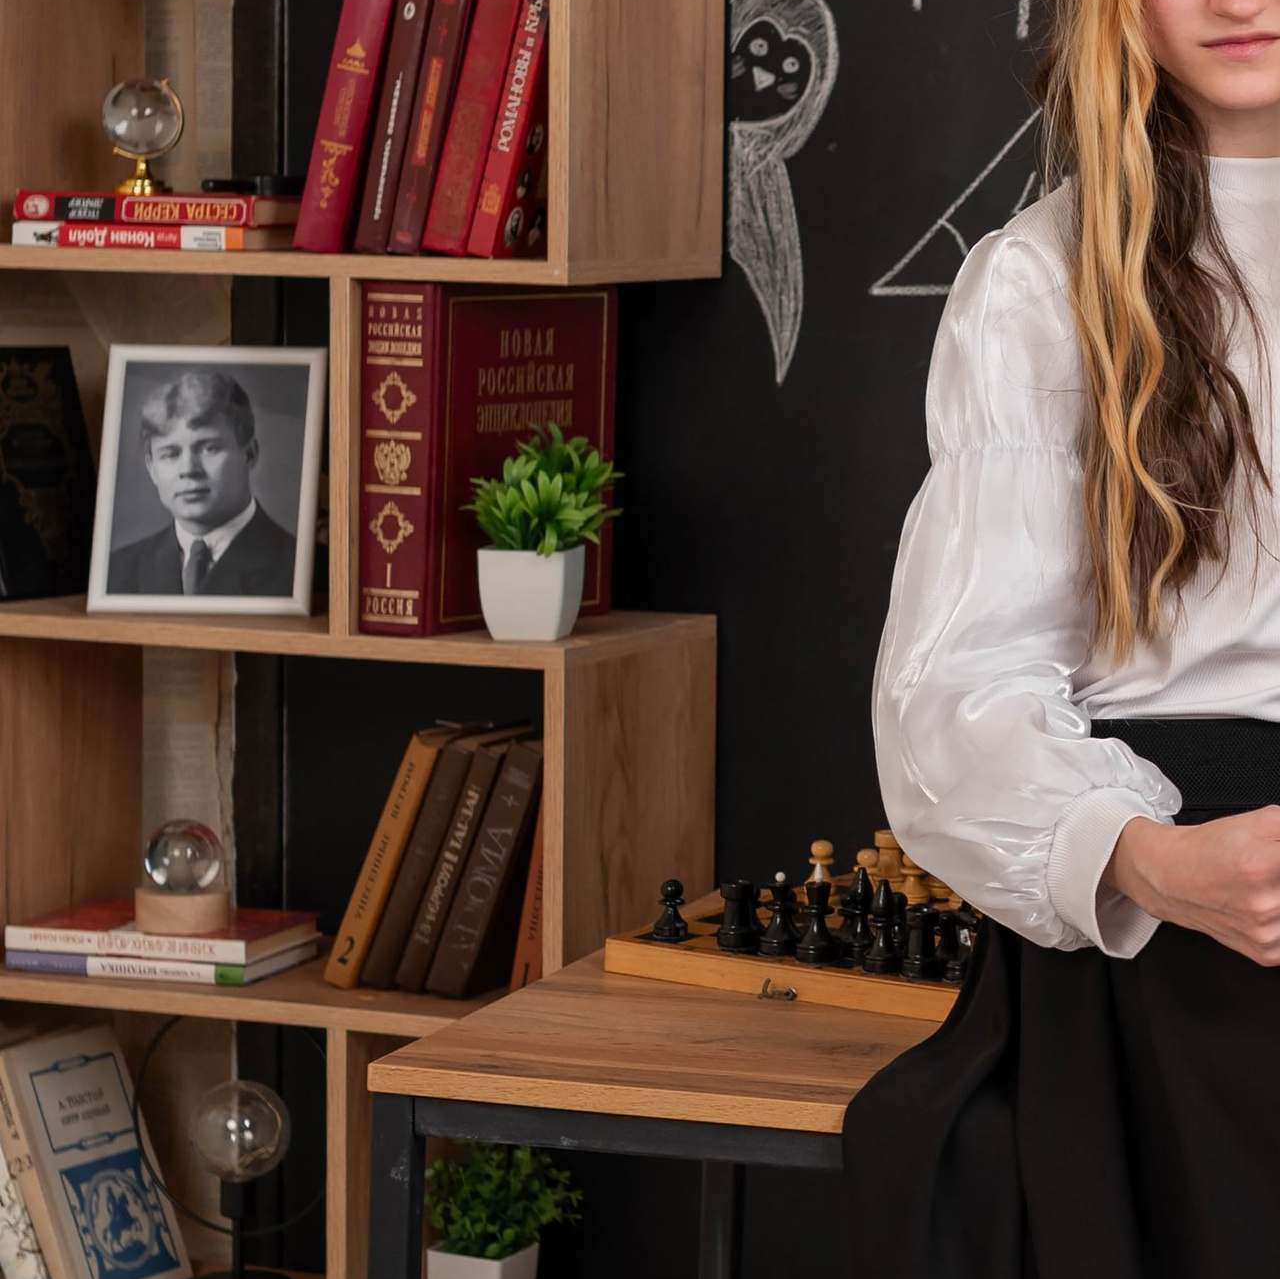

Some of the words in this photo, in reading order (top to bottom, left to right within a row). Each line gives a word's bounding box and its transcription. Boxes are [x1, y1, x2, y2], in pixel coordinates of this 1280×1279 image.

[498, 45, 532, 153] РОМАНОВЫ
[134, 201, 181, 221] КЕРРИ
[186, 202, 239, 222] СЕСТРА
[68, 227, 108, 246] Дойл
[110, 230, 155, 247] Конан
[366, 321, 424, 339] РОССИЙСКАЯ
[500, 326, 555, 359] НОВАЯ
[477, 361, 576, 398] РОССИЙСКАЯ
[475, 398, 574, 436] ЭНЦИКЛОПЕДИЯ
[364, 596, 416, 620] РОССИЯ
